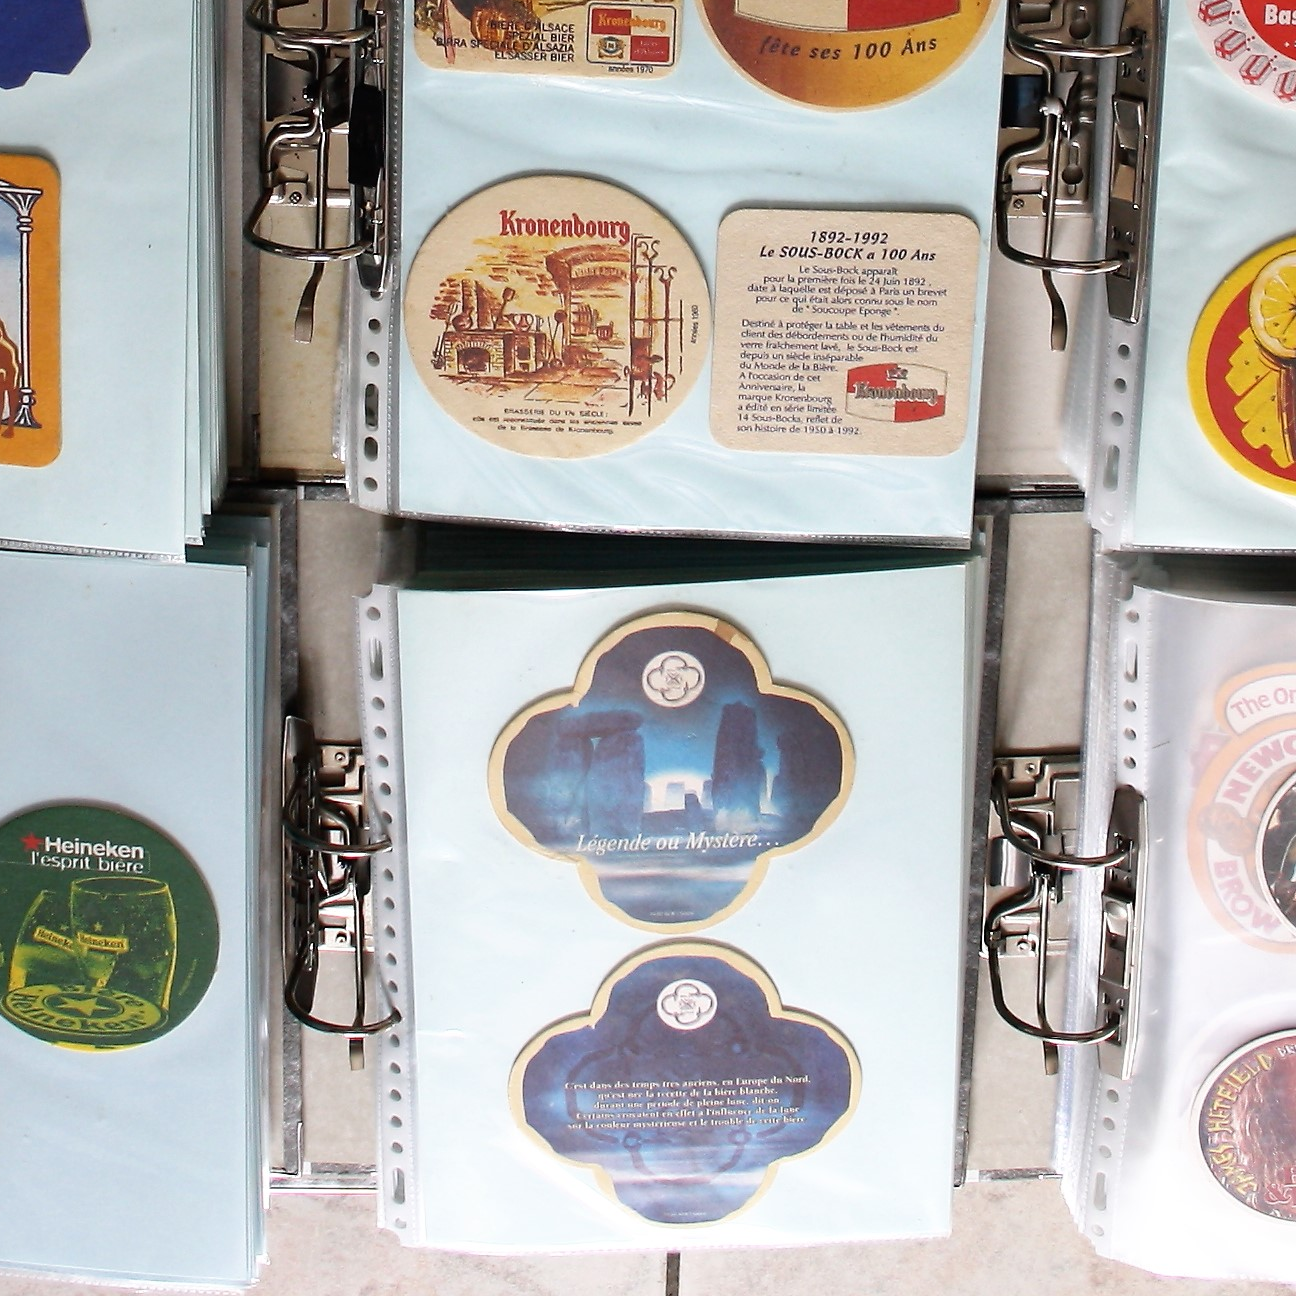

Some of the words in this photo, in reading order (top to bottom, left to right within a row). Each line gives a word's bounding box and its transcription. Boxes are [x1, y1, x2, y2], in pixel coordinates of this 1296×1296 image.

[758, 35, 801, 55] fête
[808, 45, 841, 60] ses
[853, 41, 893, 60] 100
[900, 37, 937, 55] Ans
[499, 209, 631, 244] Kronenbourg
[810, 230, 889, 245] 1892-1992
[759, 245, 775, 258] Le
[779, 246, 864, 261] SOUS-BOCK
[866, 251, 874, 260] a
[880, 248, 907, 261] 100
[910, 250, 936, 261] Ans
[741, 320, 775, 329] Destiné
[786, 321, 823, 332] protéger
[824, 322, 833, 330] la
[860, 324, 869, 332] et
[871, 323, 883, 332] les
[932, 323, 945, 332] du
[1230, 692, 1272, 720] The
[44, 836, 144, 859] Heineken
[31, 851, 90, 871] l'esprit
[99, 856, 144, 874] bière
